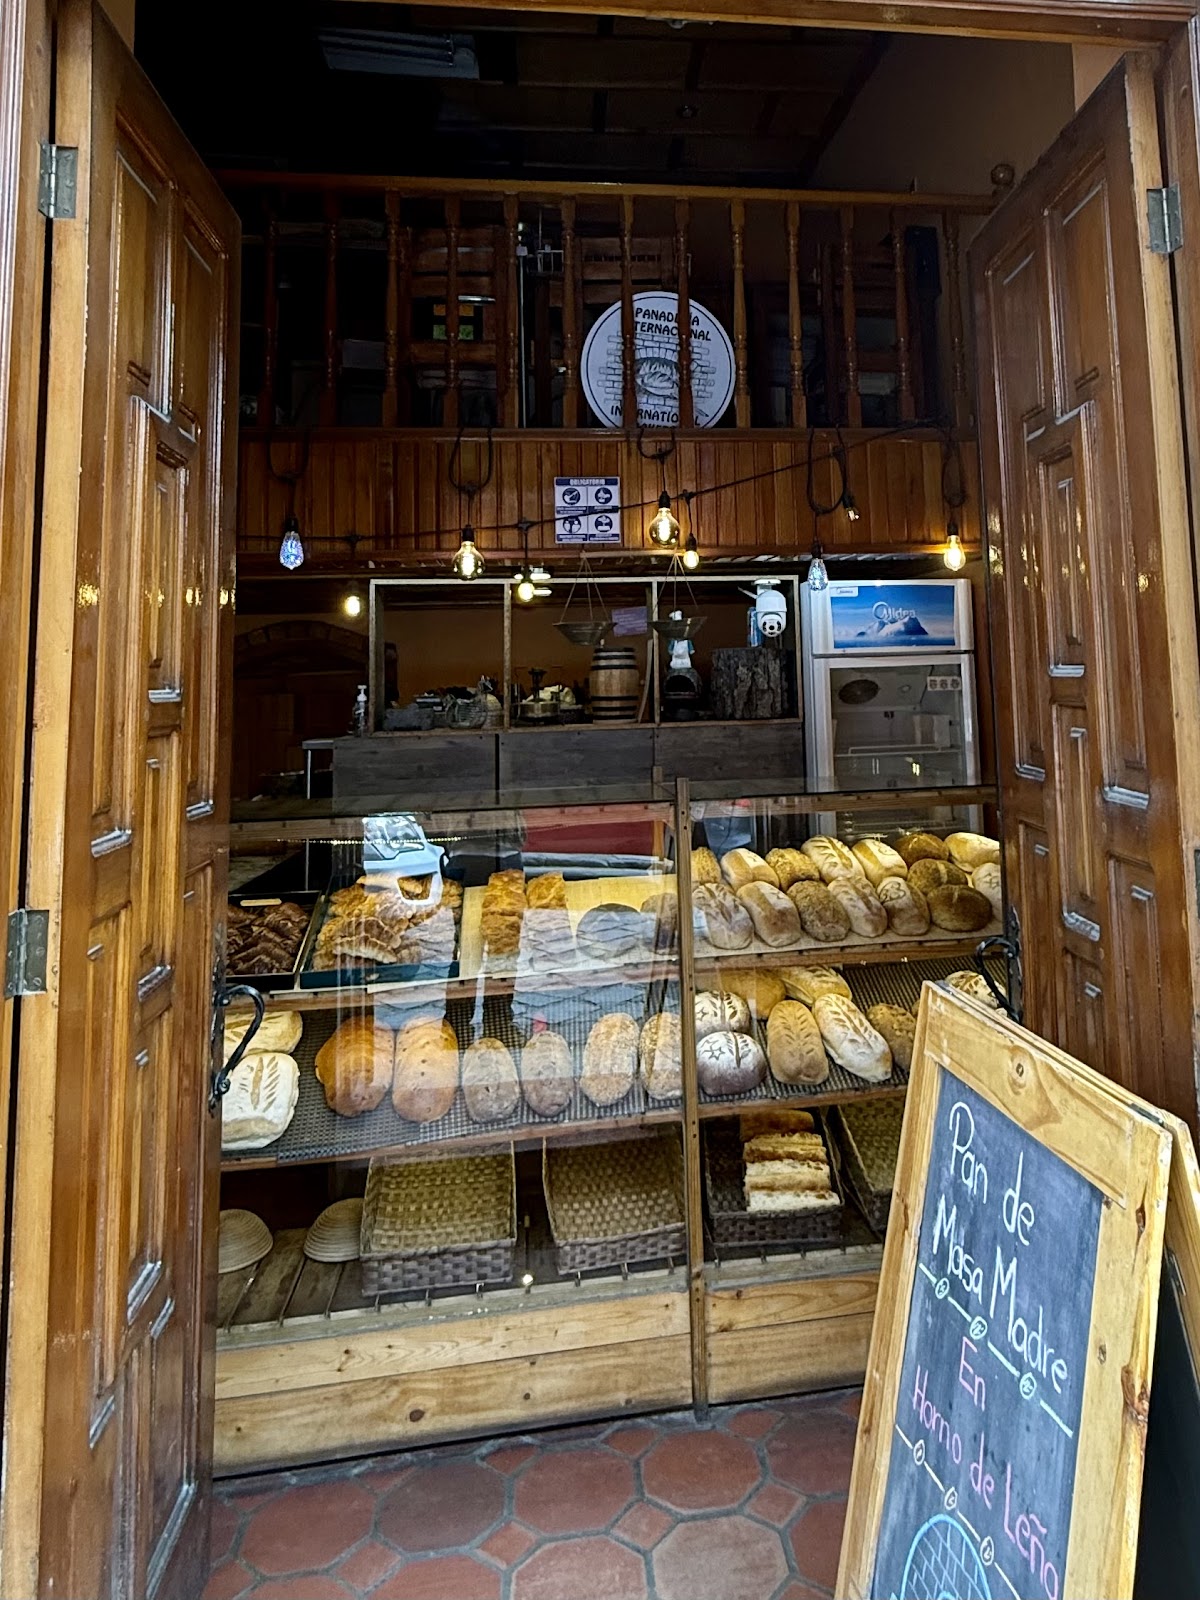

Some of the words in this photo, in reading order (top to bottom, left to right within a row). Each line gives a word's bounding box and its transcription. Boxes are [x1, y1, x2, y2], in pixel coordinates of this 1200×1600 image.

[635, 307, 700, 326] PANADA
[635, 321, 711, 342] TERNACNAL
[610, 404, 701, 426] INRNATIOL
[949, 1101, 988, 1204] Pan
[1003, 1151, 1035, 1246] de
[933, 1193, 984, 1305] Masa
[989, 1246, 1068, 1394] Madre
[959, 1336, 986, 1412] En
[912, 1364, 962, 1464] Horno
[970, 1431, 994, 1510] de
